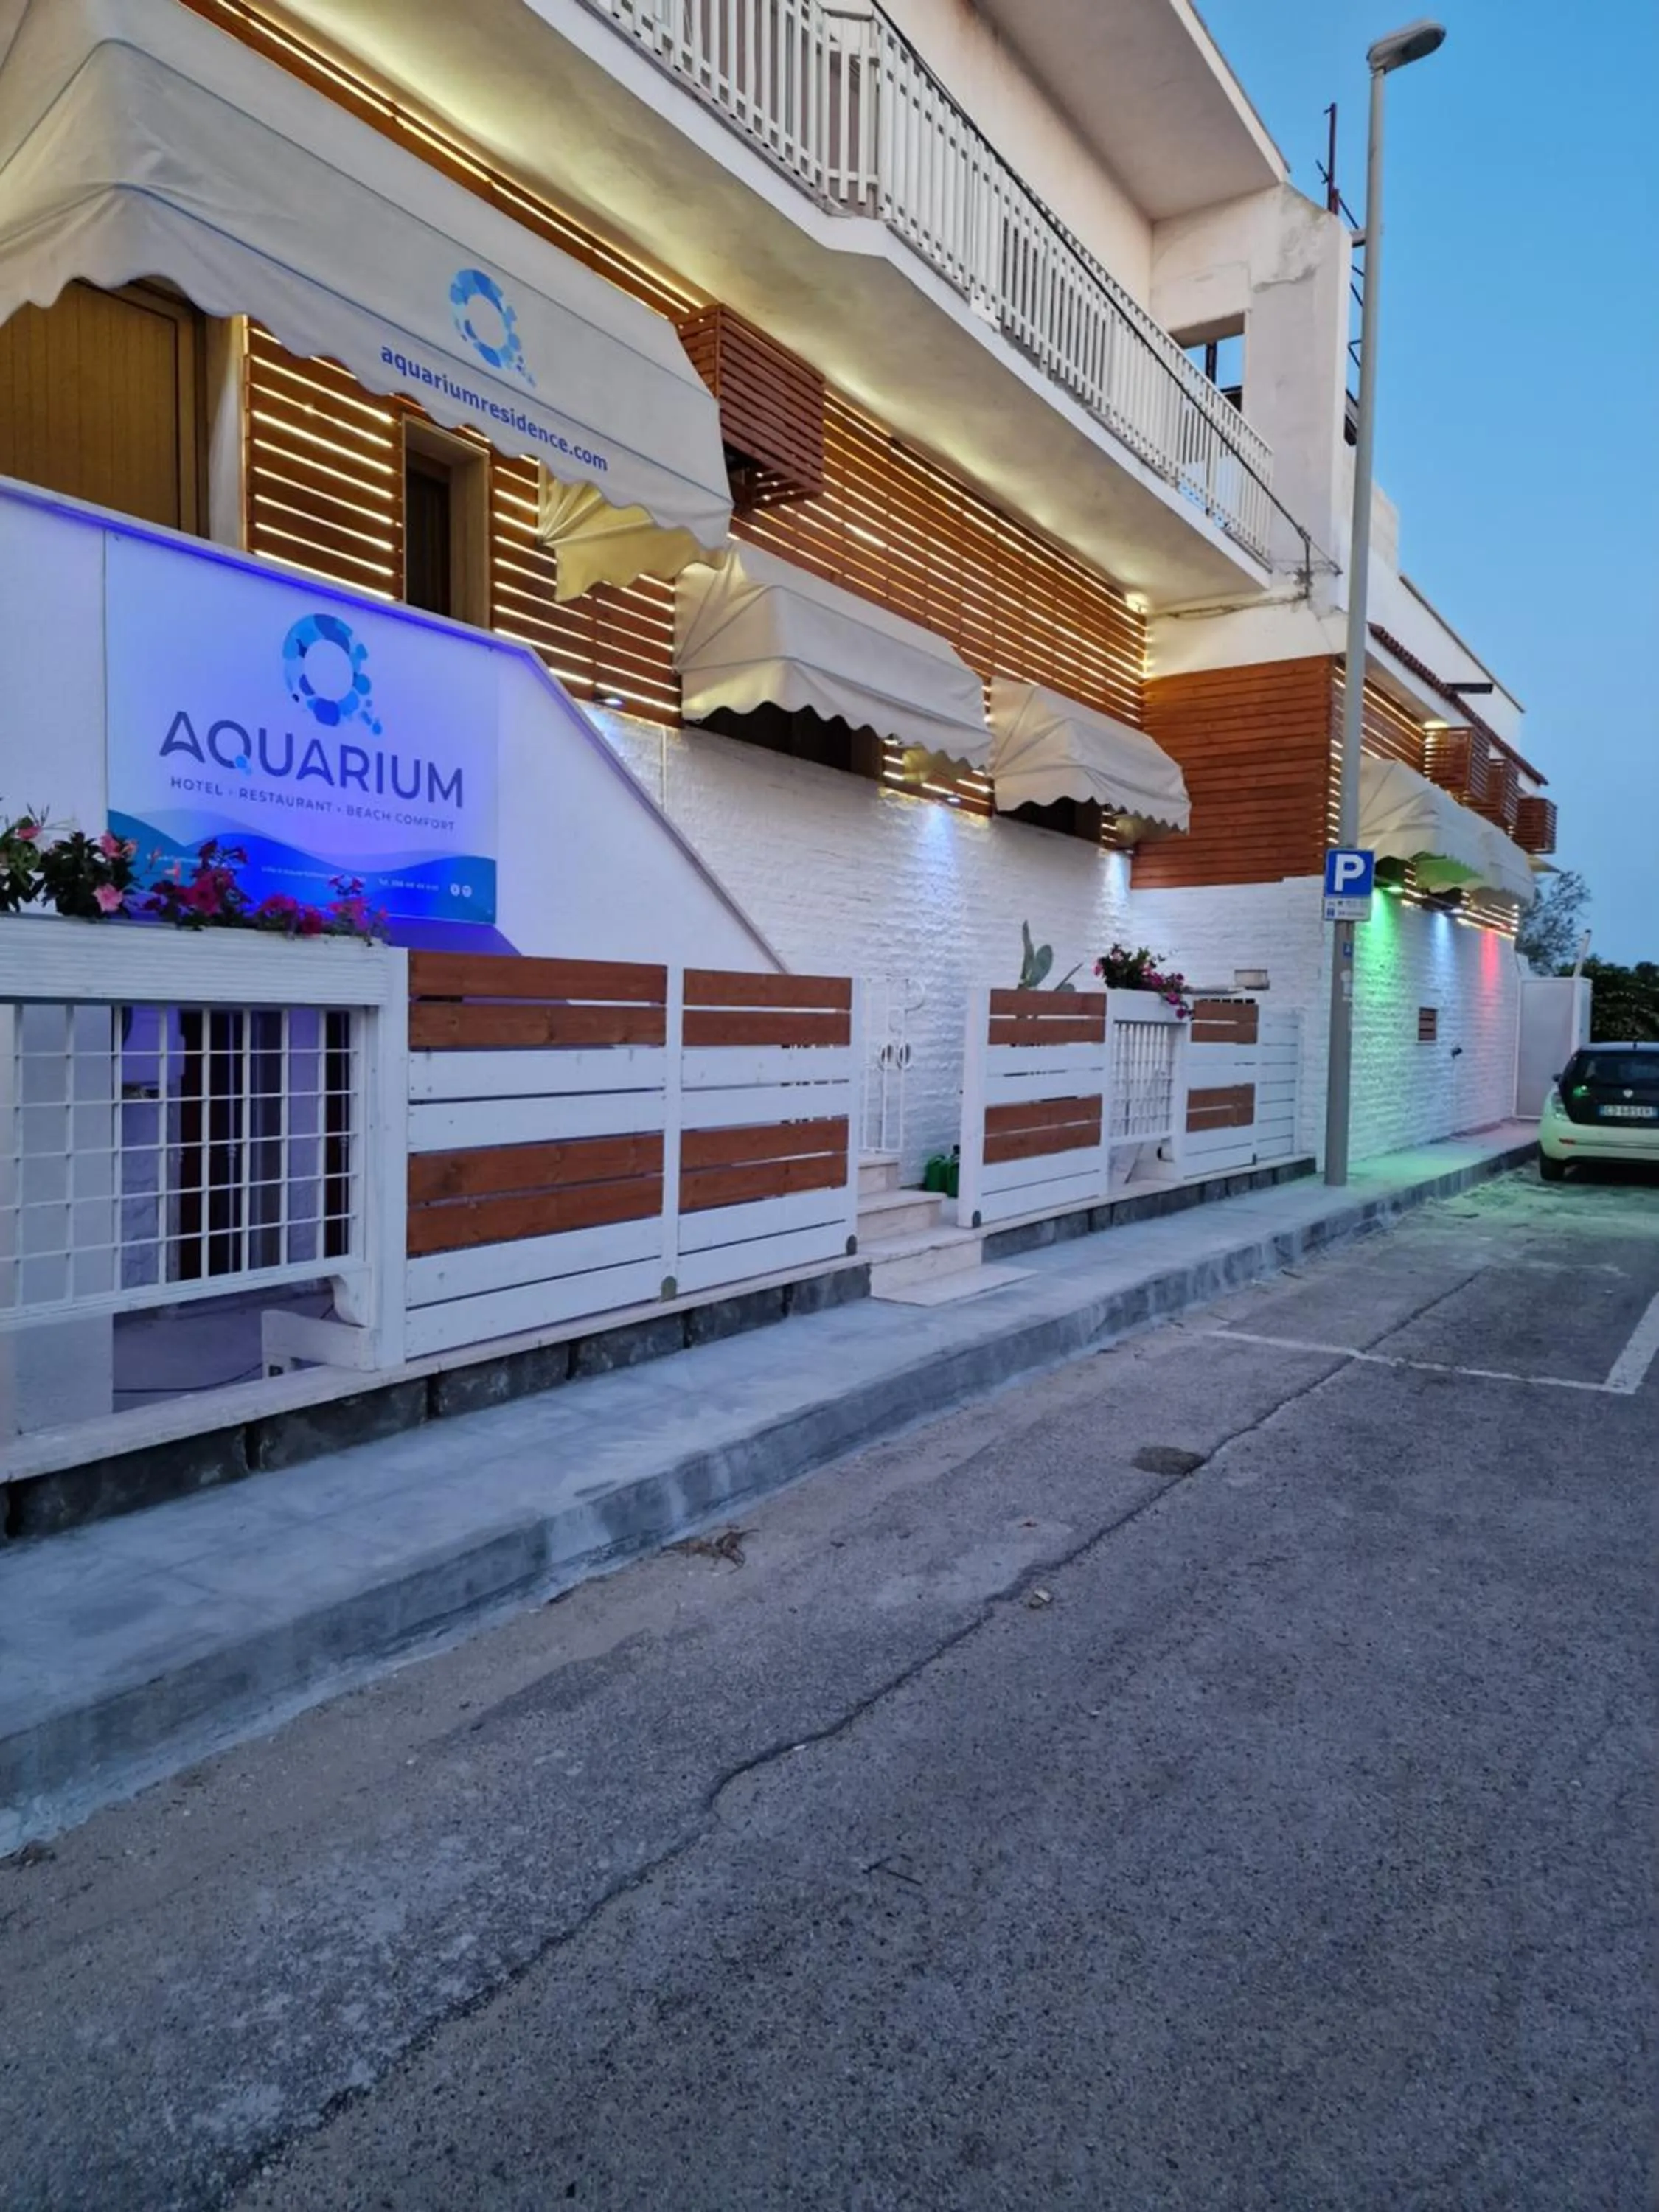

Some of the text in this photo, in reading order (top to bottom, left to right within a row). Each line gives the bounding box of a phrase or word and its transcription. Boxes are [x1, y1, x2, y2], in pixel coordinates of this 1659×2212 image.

[380, 345, 608, 473] aquariumresidence.com
[159, 711, 463, 809] AQUARIUM
[170, 776, 455, 831] HOTEL RESTAURANT BEACH COMFORT
[1334, 853, 1366, 891] P
